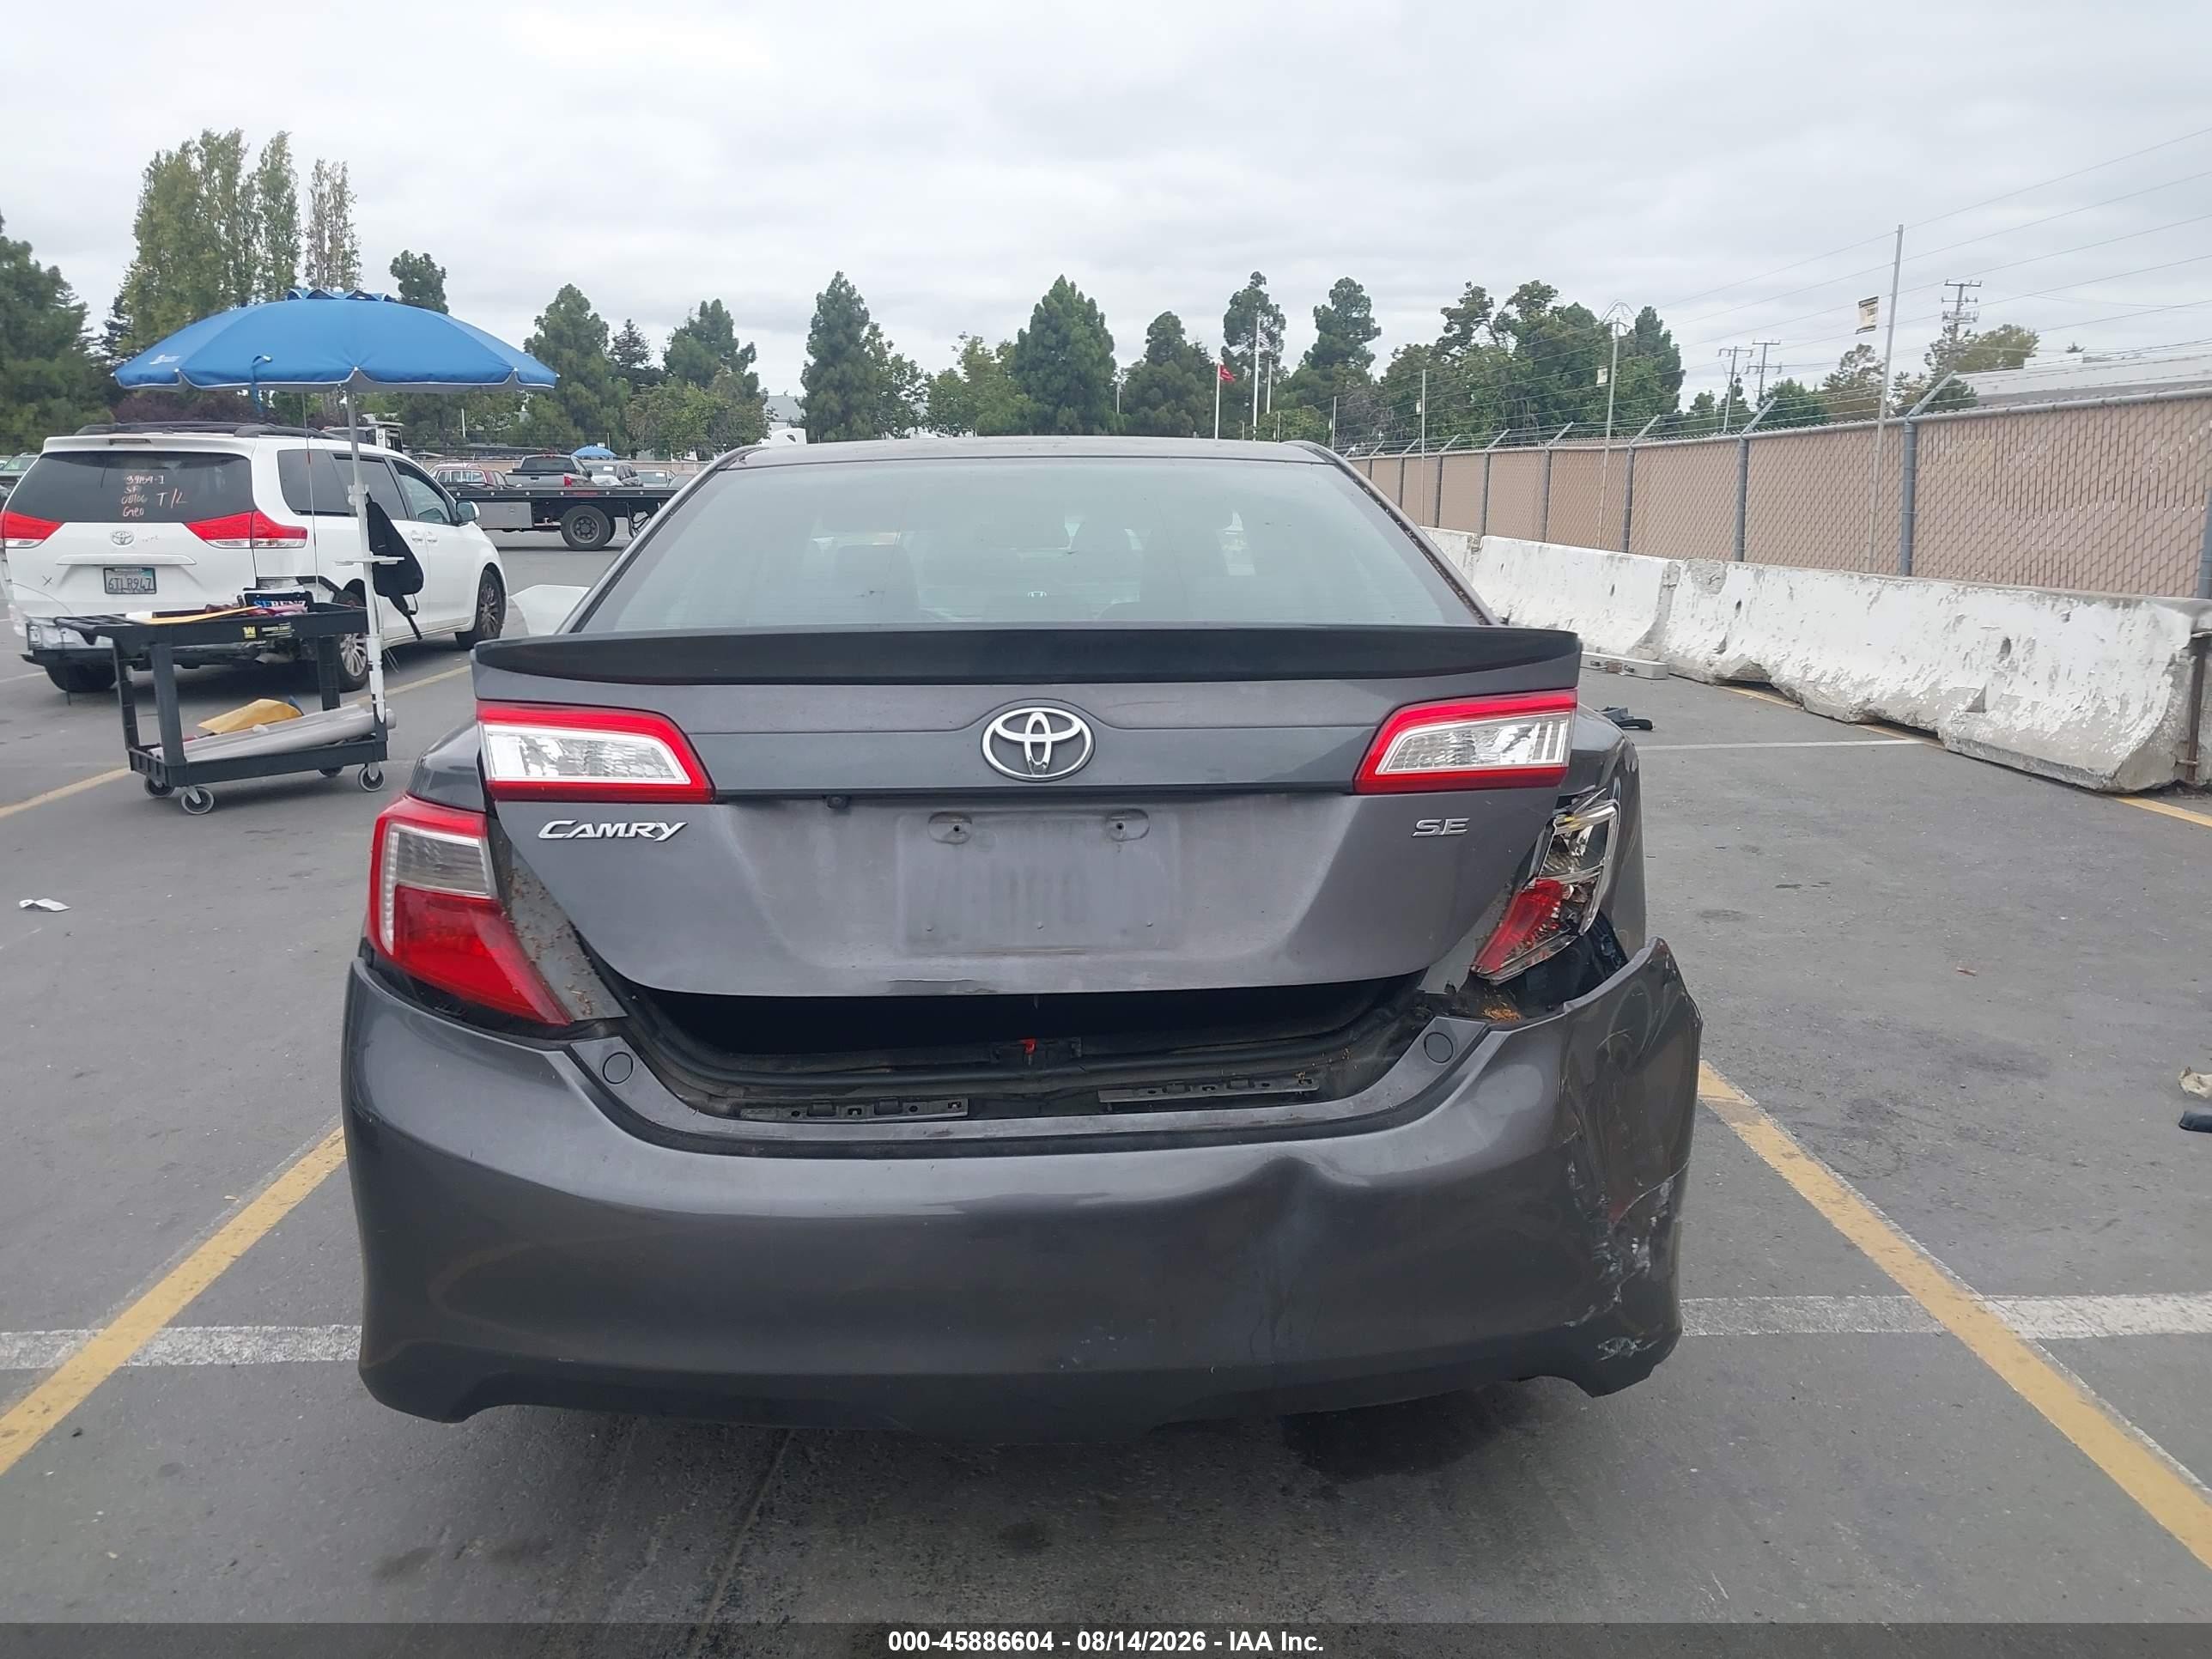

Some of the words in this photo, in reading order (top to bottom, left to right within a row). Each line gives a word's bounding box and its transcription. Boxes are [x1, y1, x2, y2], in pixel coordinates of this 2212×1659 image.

[108, 577, 151, 591] 6TLR947
[538, 819, 688, 842] CAMRY
[1411, 817, 1470, 838] SE
